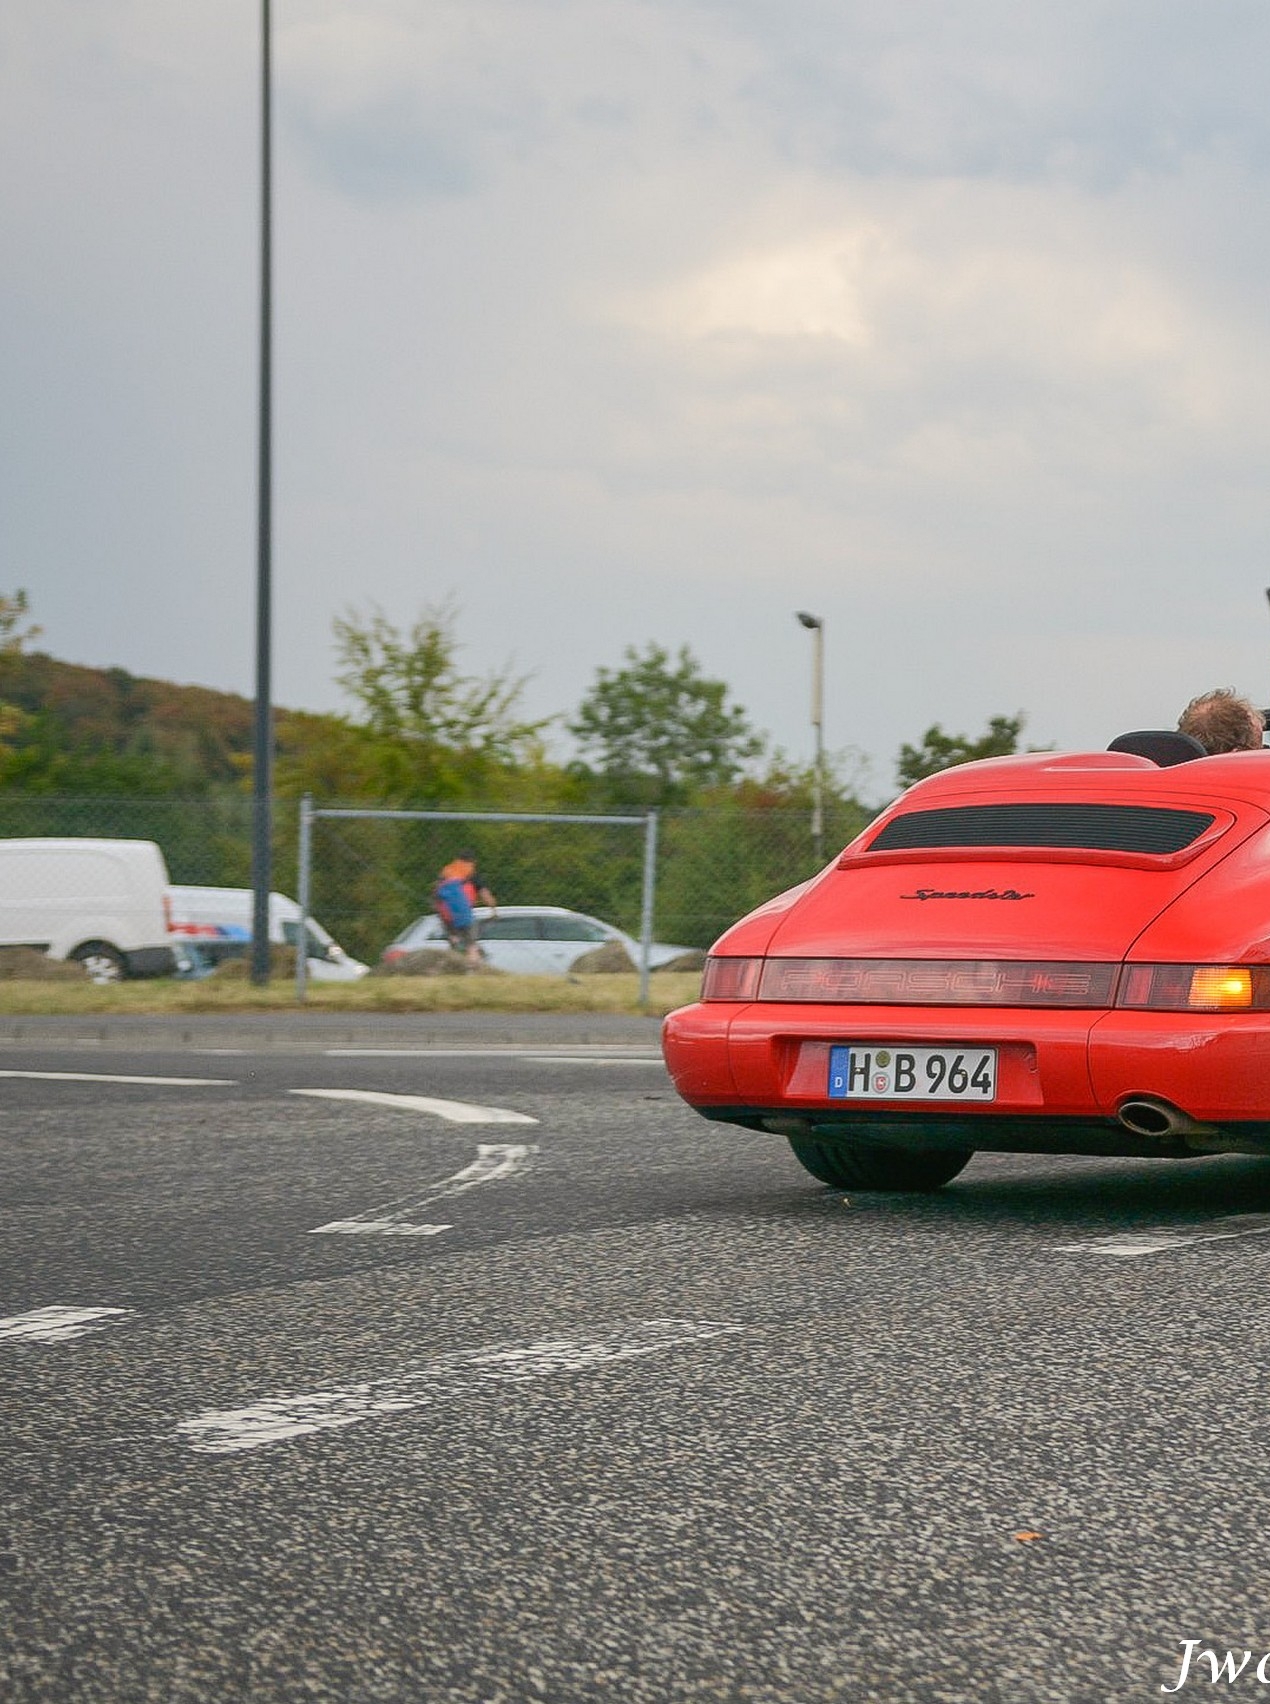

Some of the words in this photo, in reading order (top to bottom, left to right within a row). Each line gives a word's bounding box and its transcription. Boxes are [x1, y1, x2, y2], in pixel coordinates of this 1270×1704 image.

[782, 969, 1092, 995] PORSCHE
[834, 1076, 843, 1088] D
[926, 1054, 992, 1094] 964
